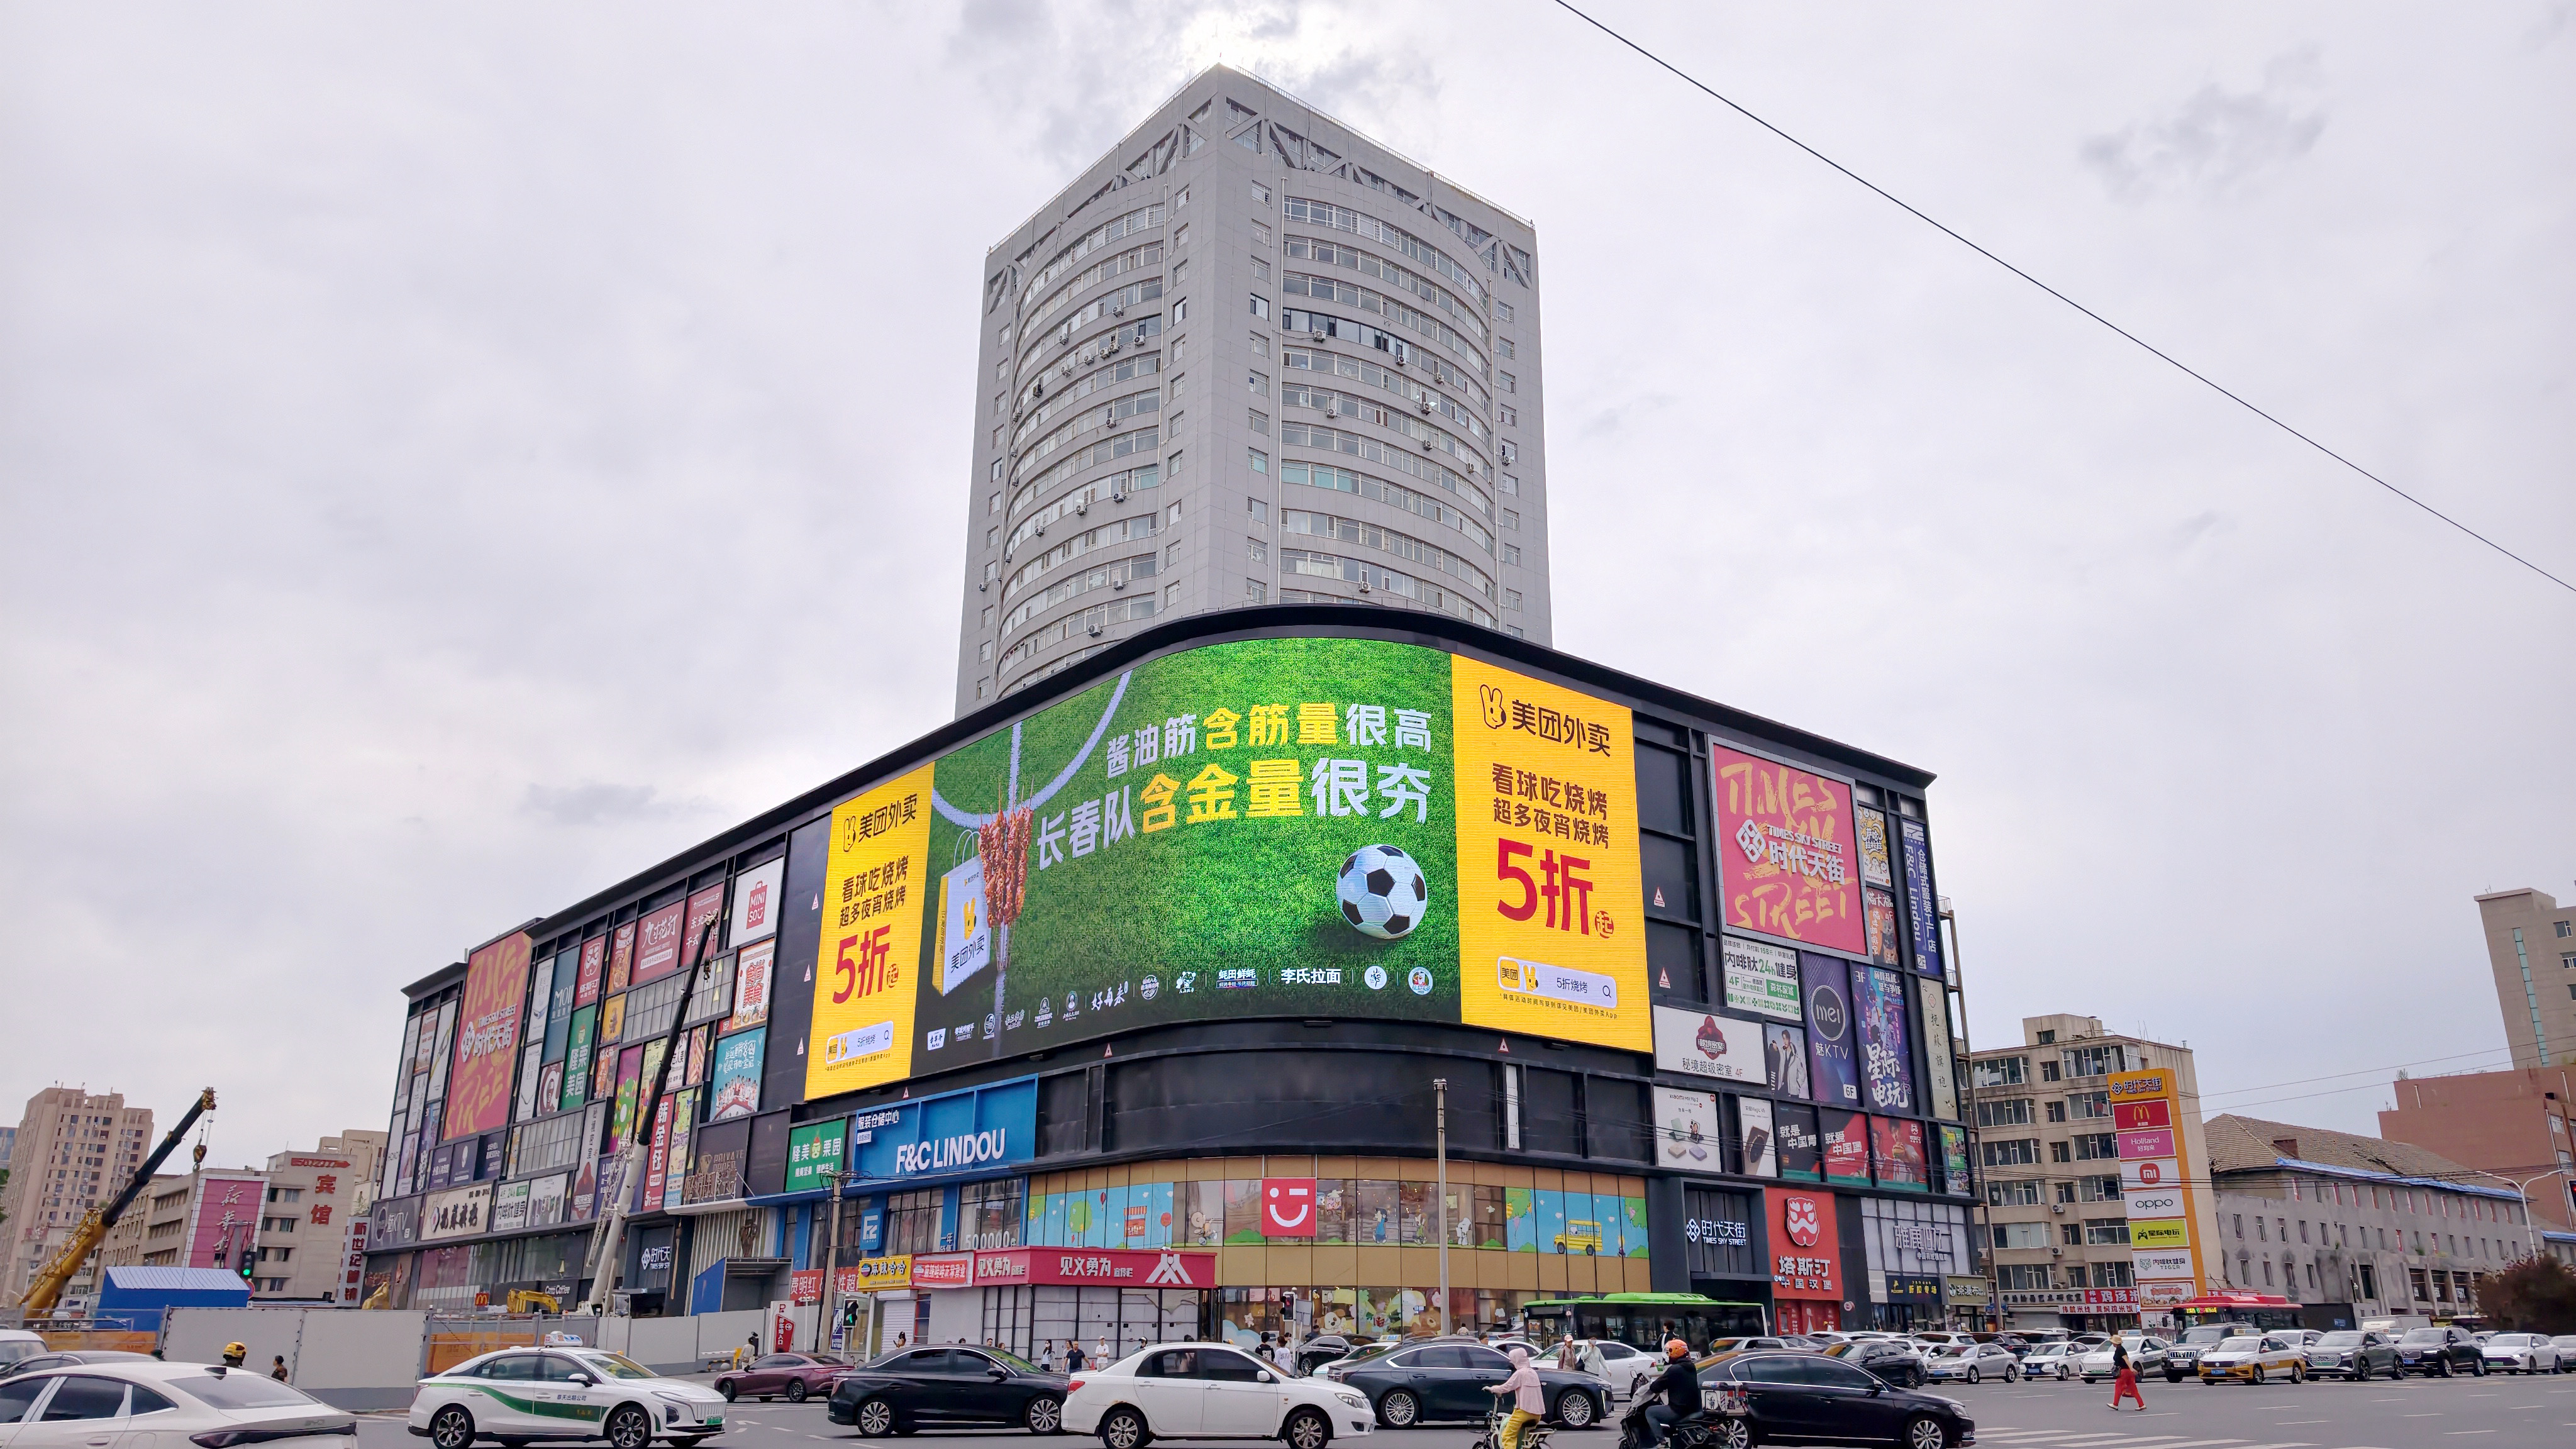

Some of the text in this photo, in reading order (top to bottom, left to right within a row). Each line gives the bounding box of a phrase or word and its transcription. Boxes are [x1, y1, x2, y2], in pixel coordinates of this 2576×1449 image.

[1106, 702, 1432, 778] 酱油筋含筋量很高
[1512, 699, 1611, 757] 美团外卖
[1492, 763, 1607, 821] 看球吃烧烤
[858, 794, 918, 845] 美团外卖
[1036, 758, 1432, 871] 长春队含金量很夯
[1494, 797, 1609, 849] 超多夜宵烧烤
[1767, 824, 1794, 841] TIMES
[1794, 833, 1811, 845] SKY
[1813, 838, 1842, 854] STREET
[1768, 841, 1845, 885] 时代天街
[842, 855, 909, 902] 看球吃烧烤
[750, 892, 765, 908] MINI
[839, 884, 907, 928] 超多夜宵烧烤
[1906, 845, 1921, 941] F&C Lindou
[951, 935, 984, 973] 美团外卖
[1281, 968, 1341, 984] 李氏拉面
[1502, 967, 1518, 980] 美团
[1557, 977, 1587, 994] 5折烧烤
[1729, 976, 1740, 985] 4F
[1091, 983, 1125, 1011] 好再来
[1816, 1041, 1848, 1060] 魅KTV
[1866, 1043, 1900, 1080] 星际
[1682, 1058, 1743, 1077] 秘境超级密室 4F
[1846, 1086, 1854, 1096] 6F
[1872, 1080, 1908, 1108] 电玩
[2124, 1077, 2162, 1089] 时代天街
[858, 1110, 899, 1130] 服装仓储中心
[1780, 1124, 1801, 1138] 就是
[896, 1128, 1006, 1174] F&C LINDOU
[311, 1174, 337, 1225] 宾馆
[1702, 1220, 1746, 1238] 时代天街
[1060, 1257, 1111, 1277] 见义勇为
[1779, 1256, 1830, 1277] 塔斯汀
[779, 1304, 786, 1313] P
